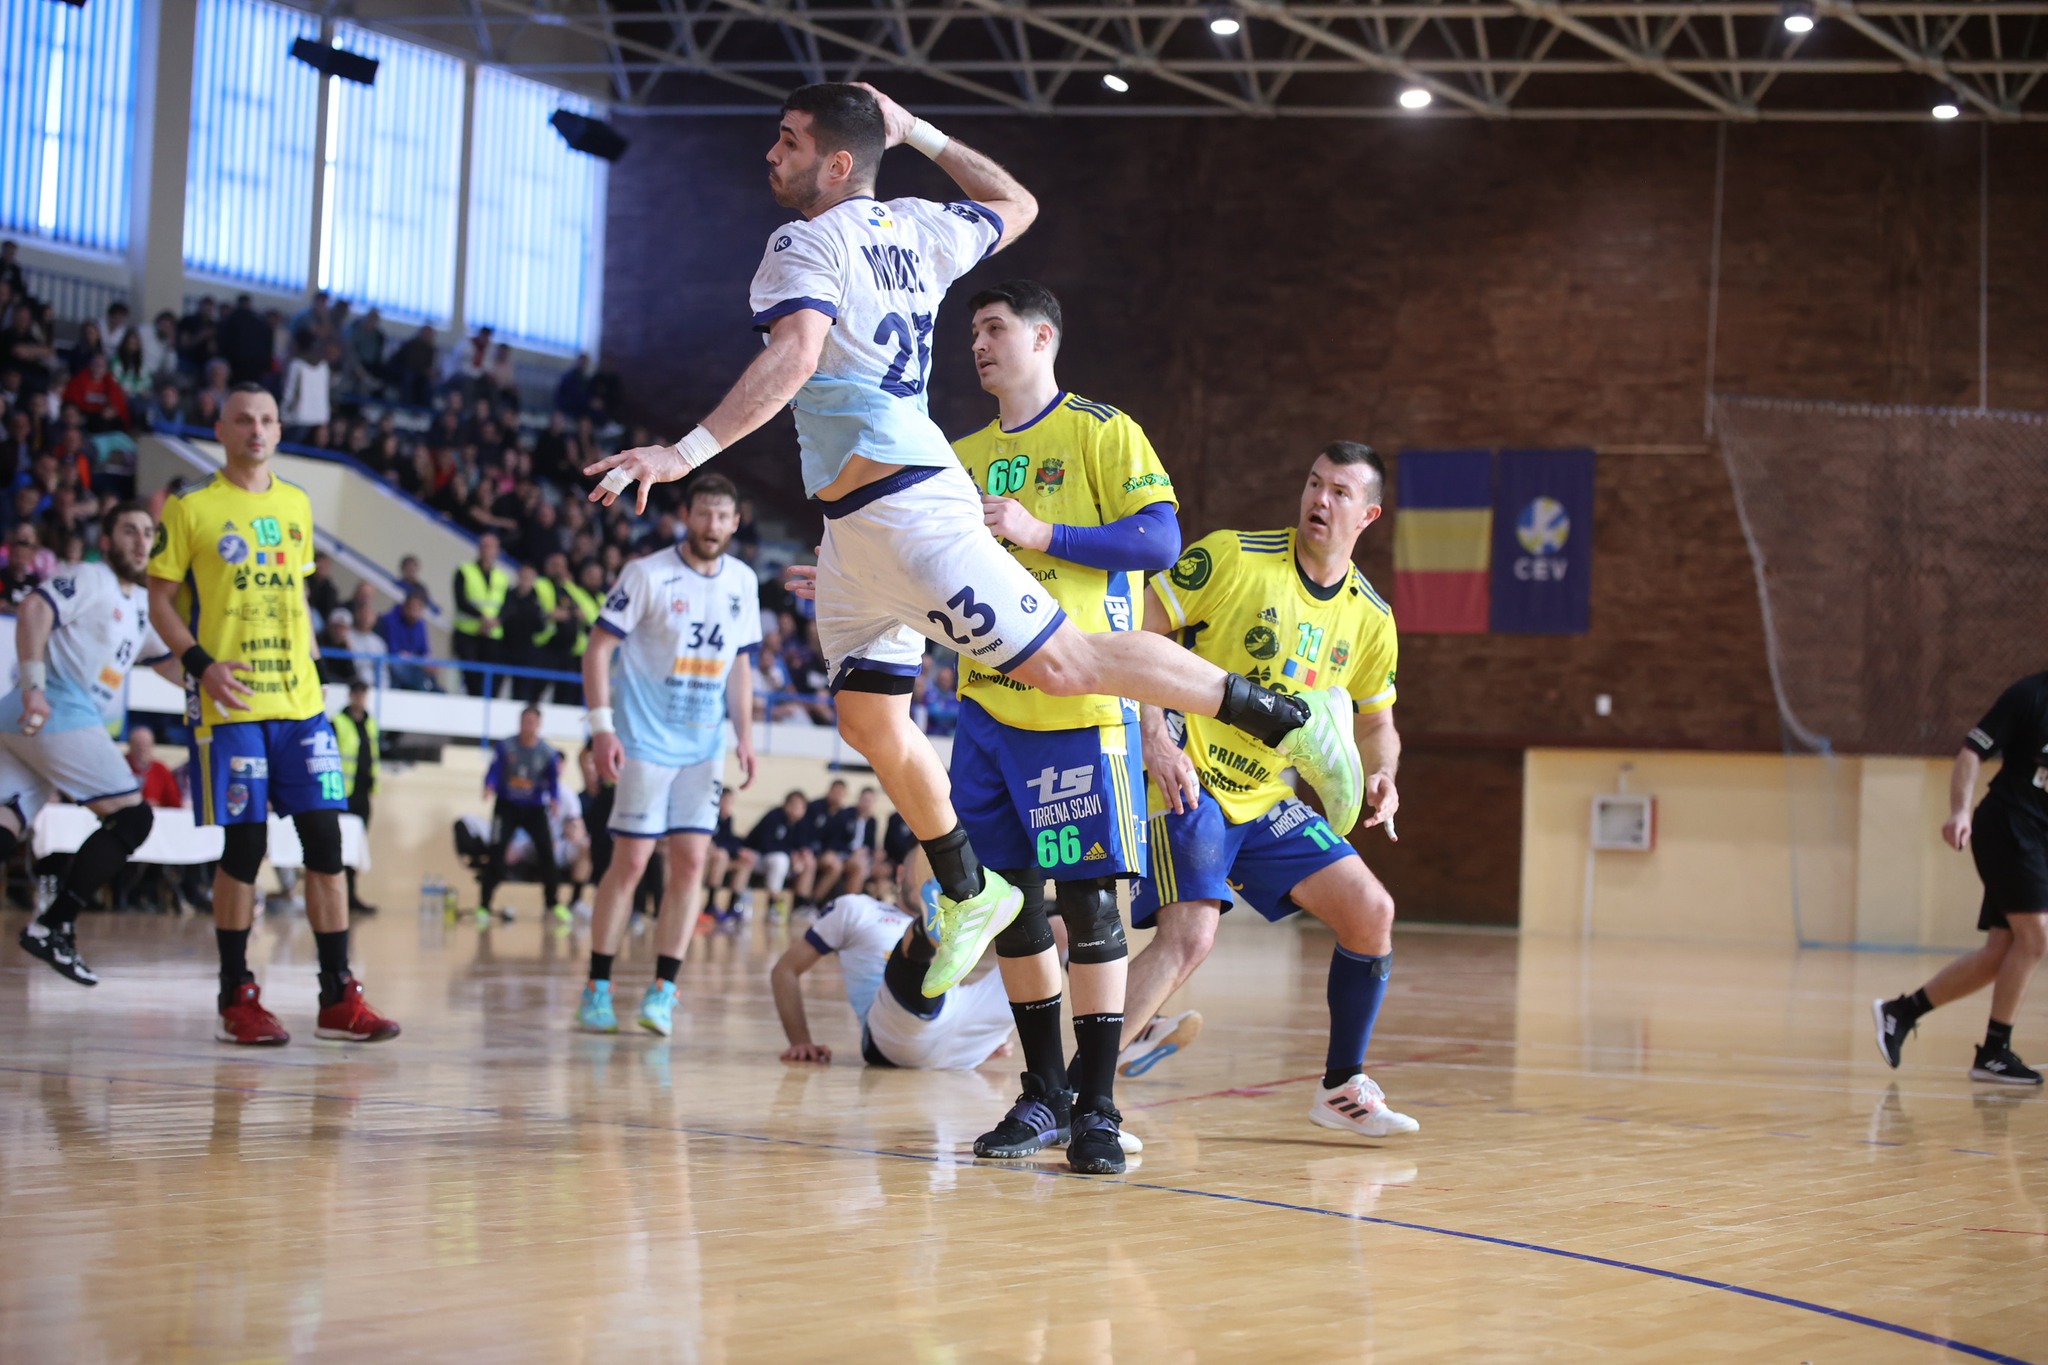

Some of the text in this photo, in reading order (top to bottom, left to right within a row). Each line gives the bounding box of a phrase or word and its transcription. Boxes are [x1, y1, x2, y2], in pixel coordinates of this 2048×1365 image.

[987, 455, 1029, 496] 66
[250, 516, 282, 547] 19
[1514, 557, 1568, 581] CEV
[927, 585, 997, 645] 23
[687, 622, 725, 652] 34
[970, 637, 1004, 658] Kempa
[1296, 622, 1325, 663] 11
[317, 771, 345, 801] 19
[1026, 764, 1095, 804] ts
[1028, 793, 1103, 829] TIRRENA SCAVI
[1037, 825, 1082, 868] 66
[1303, 820, 1341, 851] 11
[1077, 939, 1106, 948] COMPEX
